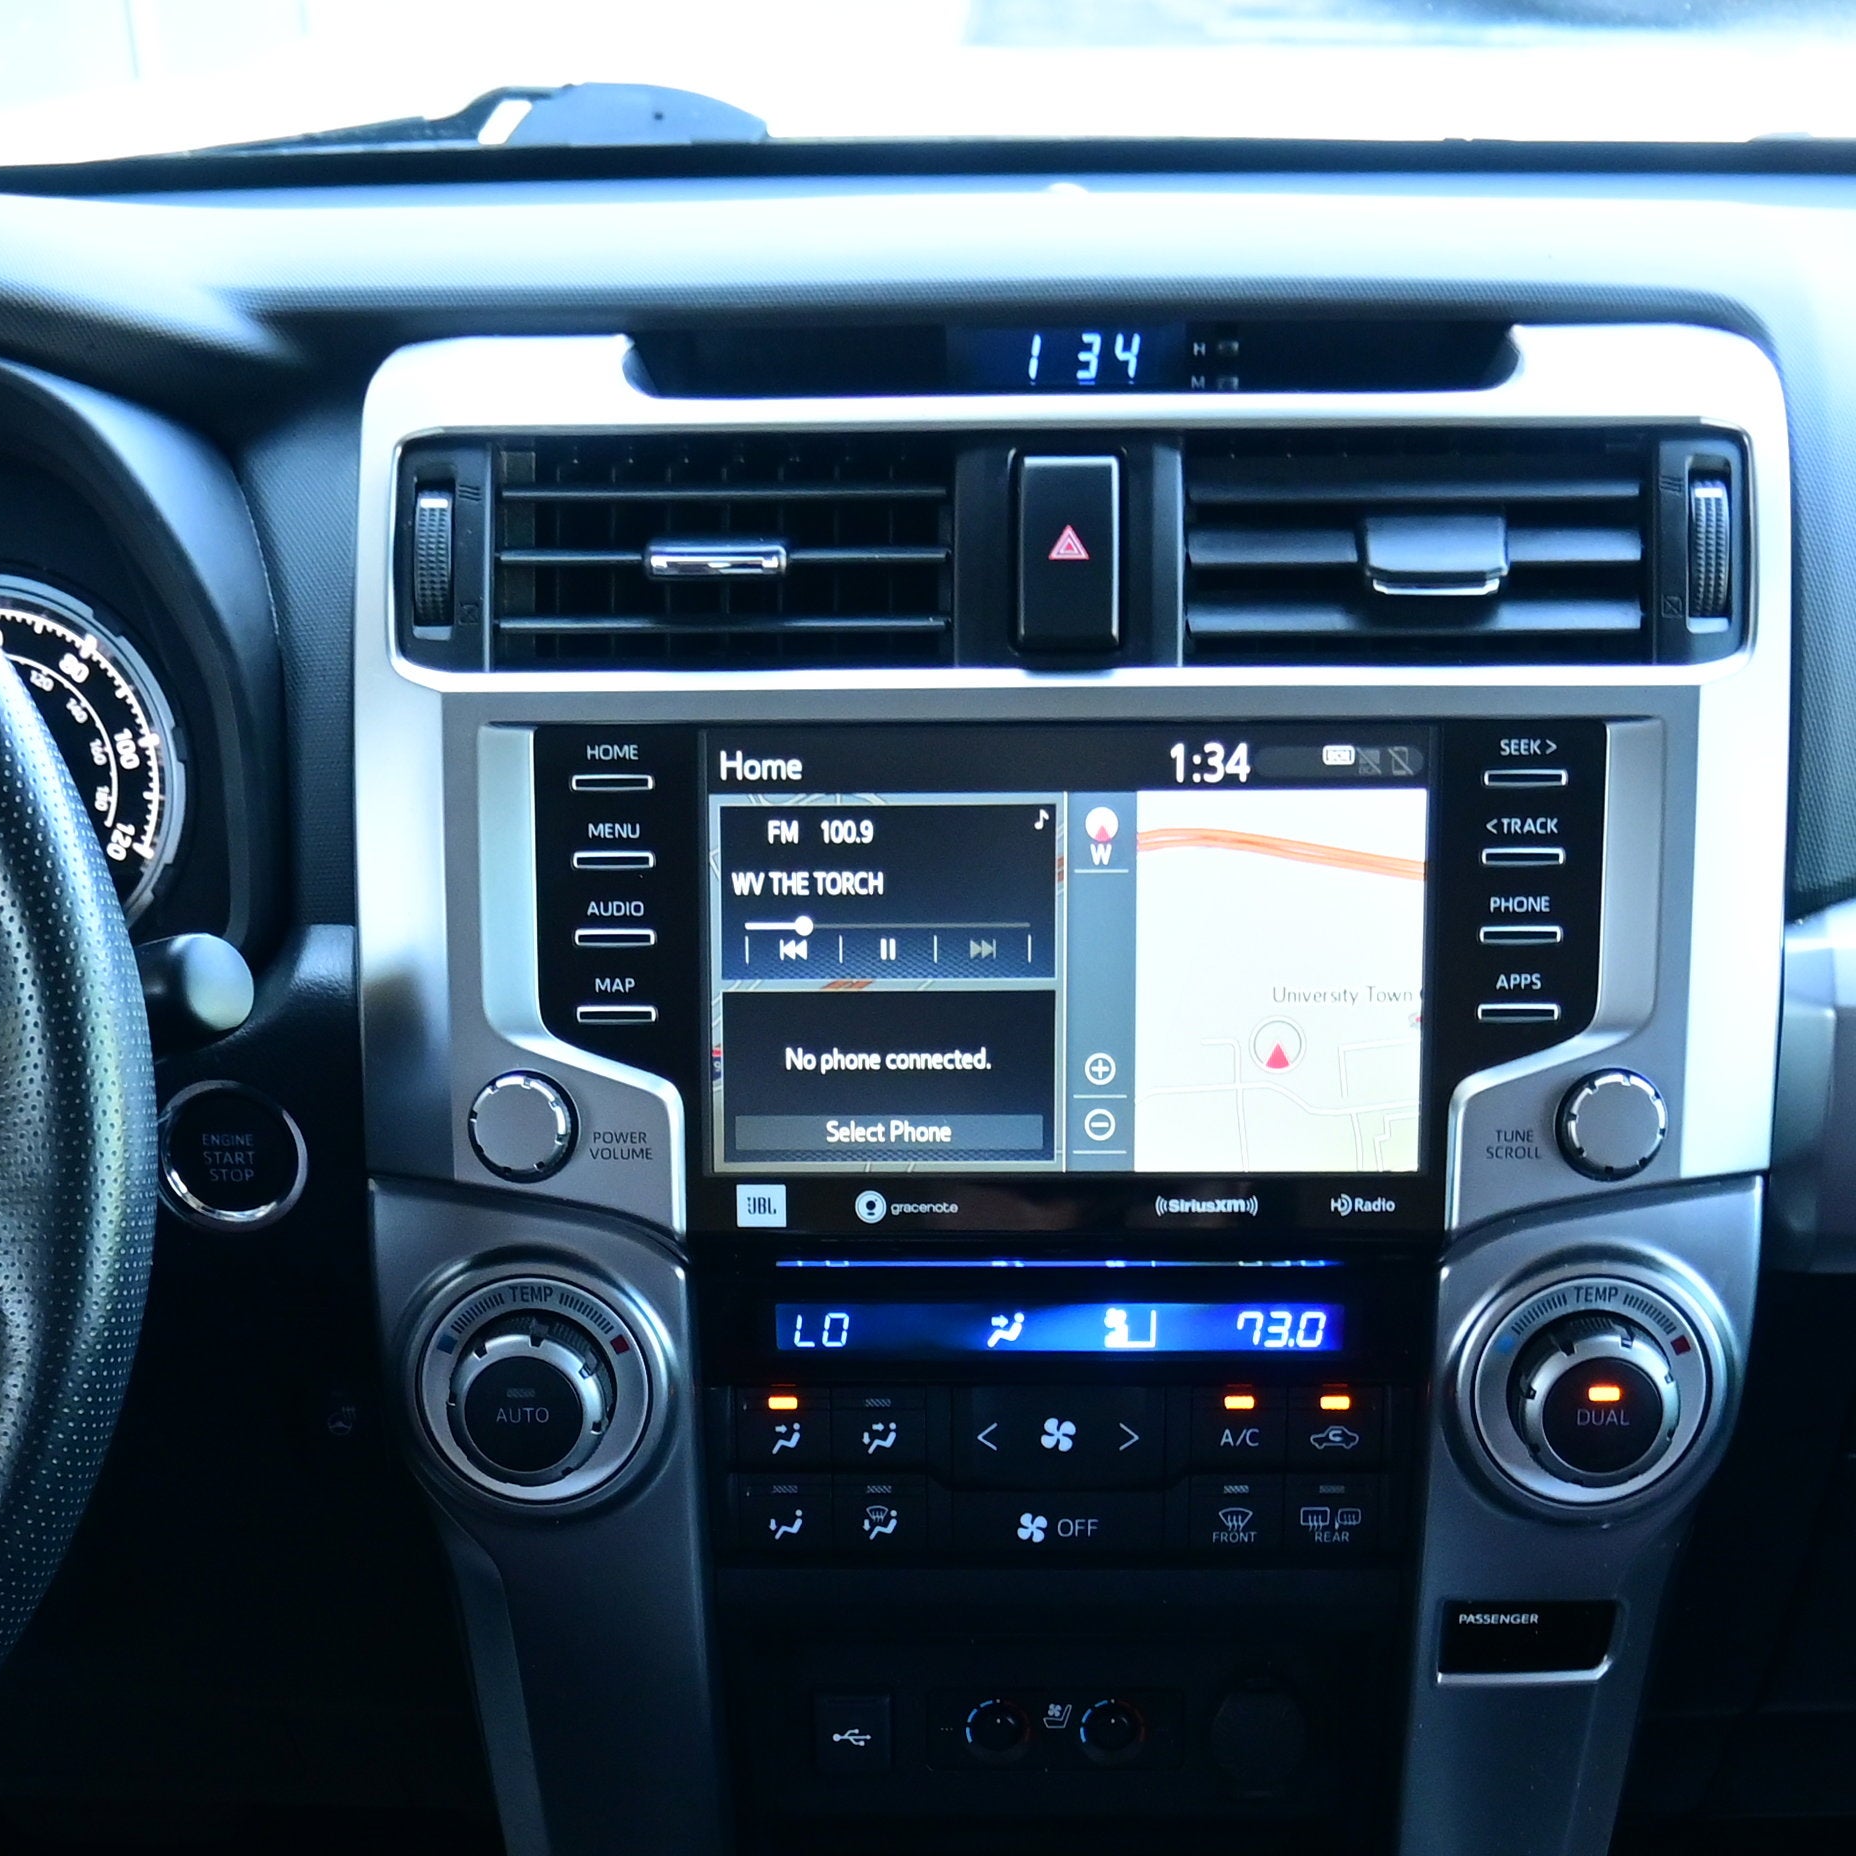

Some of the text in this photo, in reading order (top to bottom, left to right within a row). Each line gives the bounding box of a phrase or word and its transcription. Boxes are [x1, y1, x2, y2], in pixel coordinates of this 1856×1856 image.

[58, 652, 90, 684] 80
[113, 728, 141, 771] 100
[586, 744, 639, 761] HOME
[1499, 740, 1542, 756] SEEK
[719, 741, 1251, 784] Home 1:34
[588, 822, 641, 839] MENU
[767, 820, 874, 845] FM 100.9
[1500, 817, 1559, 834] TRACK
[106, 822, 136, 862] 120
[1089, 845, 1112, 865] W
[731, 871, 884, 896] WV THE TORCH
[586, 900, 644, 917] AUDIO
[1489, 896, 1550, 913] PHONE
[595, 977, 636, 993] MAP
[1496, 974, 1542, 991] APPS
[1271, 985, 1413, 1004] University Town
[785, 1047, 991, 1075] No phone connected.
[202, 1133, 255, 1147] ENGINE
[592, 1131, 648, 1146] POWER
[826, 1120, 952, 1143] Select Phone
[1495, 1129, 1534, 1144] TUNE
[203, 1151, 256, 1166] START
[589, 1146, 653, 1161] VOLUME
[1486, 1145, 1542, 1160] SCROLL
[210, 1169, 255, 1182] STOP
[747, 1197, 777, 1214] JBL
[890, 1201, 959, 1216] gracenote
[1354, 1198, 1396, 1213] Radio
[508, 1285, 554, 1303] TEMP
[1574, 1286, 1619, 1303] TEMP
[793, 1310, 1326, 1348] LO 73.0
[496, 1407, 550, 1424] AUTO
[1577, 1408, 1631, 1426] DUAL
[1220, 1428, 1261, 1447] A/C
[1057, 1518, 1099, 1538] OFF
[1212, 1531, 1258, 1543] FRONT
[1314, 1531, 1350, 1543] REAR
[1458, 1613, 1539, 1625] PASSENGER
